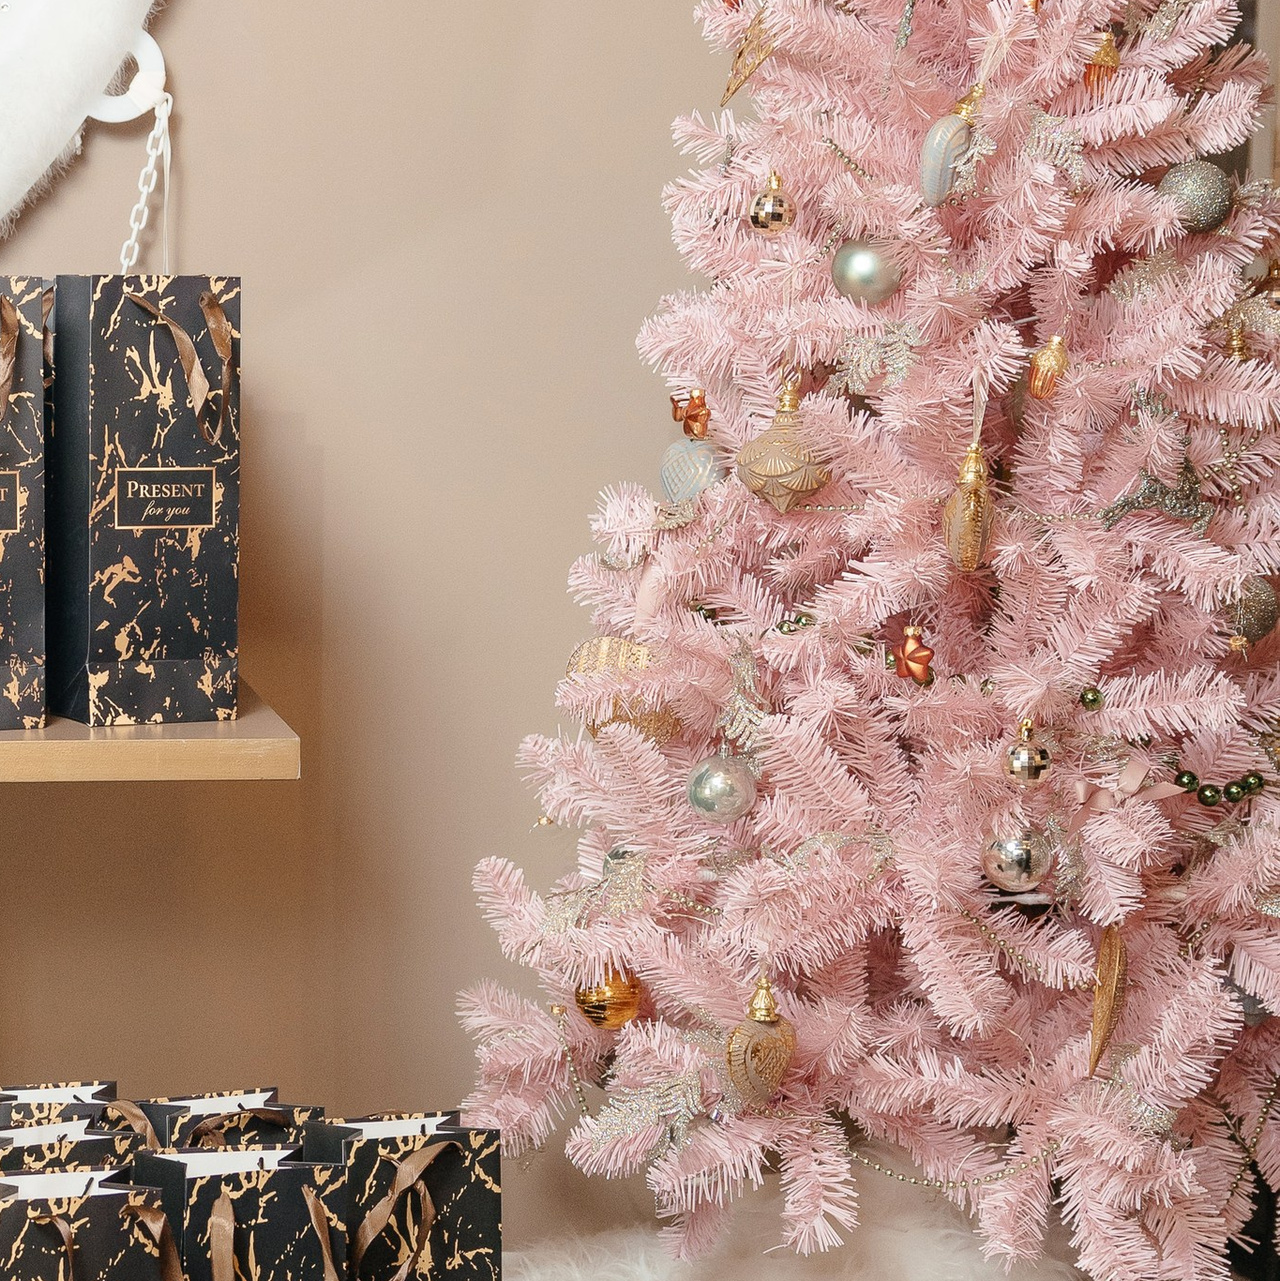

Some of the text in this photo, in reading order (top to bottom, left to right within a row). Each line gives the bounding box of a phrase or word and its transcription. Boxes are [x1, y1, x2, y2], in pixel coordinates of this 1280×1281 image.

[126, 480, 205, 498] PRESENT
[141, 500, 191, 522] for you
